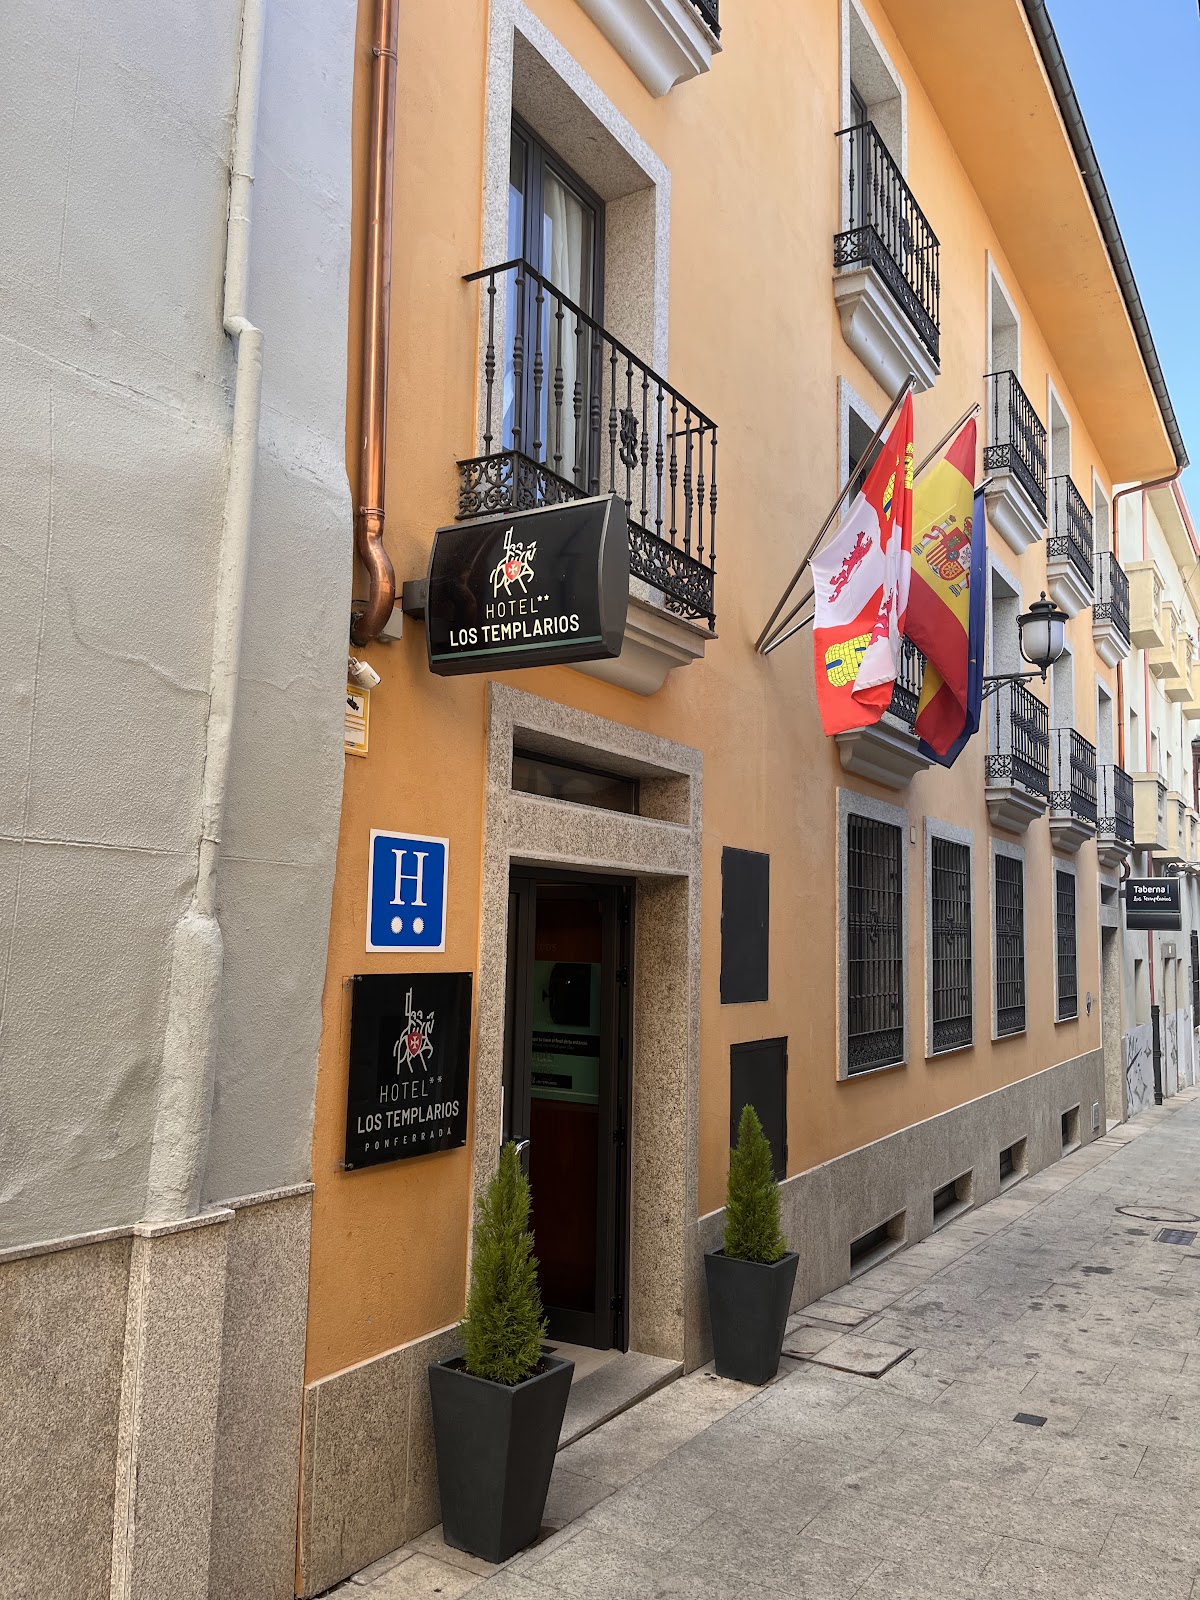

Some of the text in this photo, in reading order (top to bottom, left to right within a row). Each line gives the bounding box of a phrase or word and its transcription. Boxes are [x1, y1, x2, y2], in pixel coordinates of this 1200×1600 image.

[450, 614, 580, 646] LOS TEMPLARIOS
[389, 848, 430, 906] H
[1133, 885, 1166, 893] Taberna
[1143, 895, 1172, 903] Templarios
[357, 1100, 459, 1134] LOS TEMPLARIOS
[365, 1127, 452, 1152] PONFERRADA
